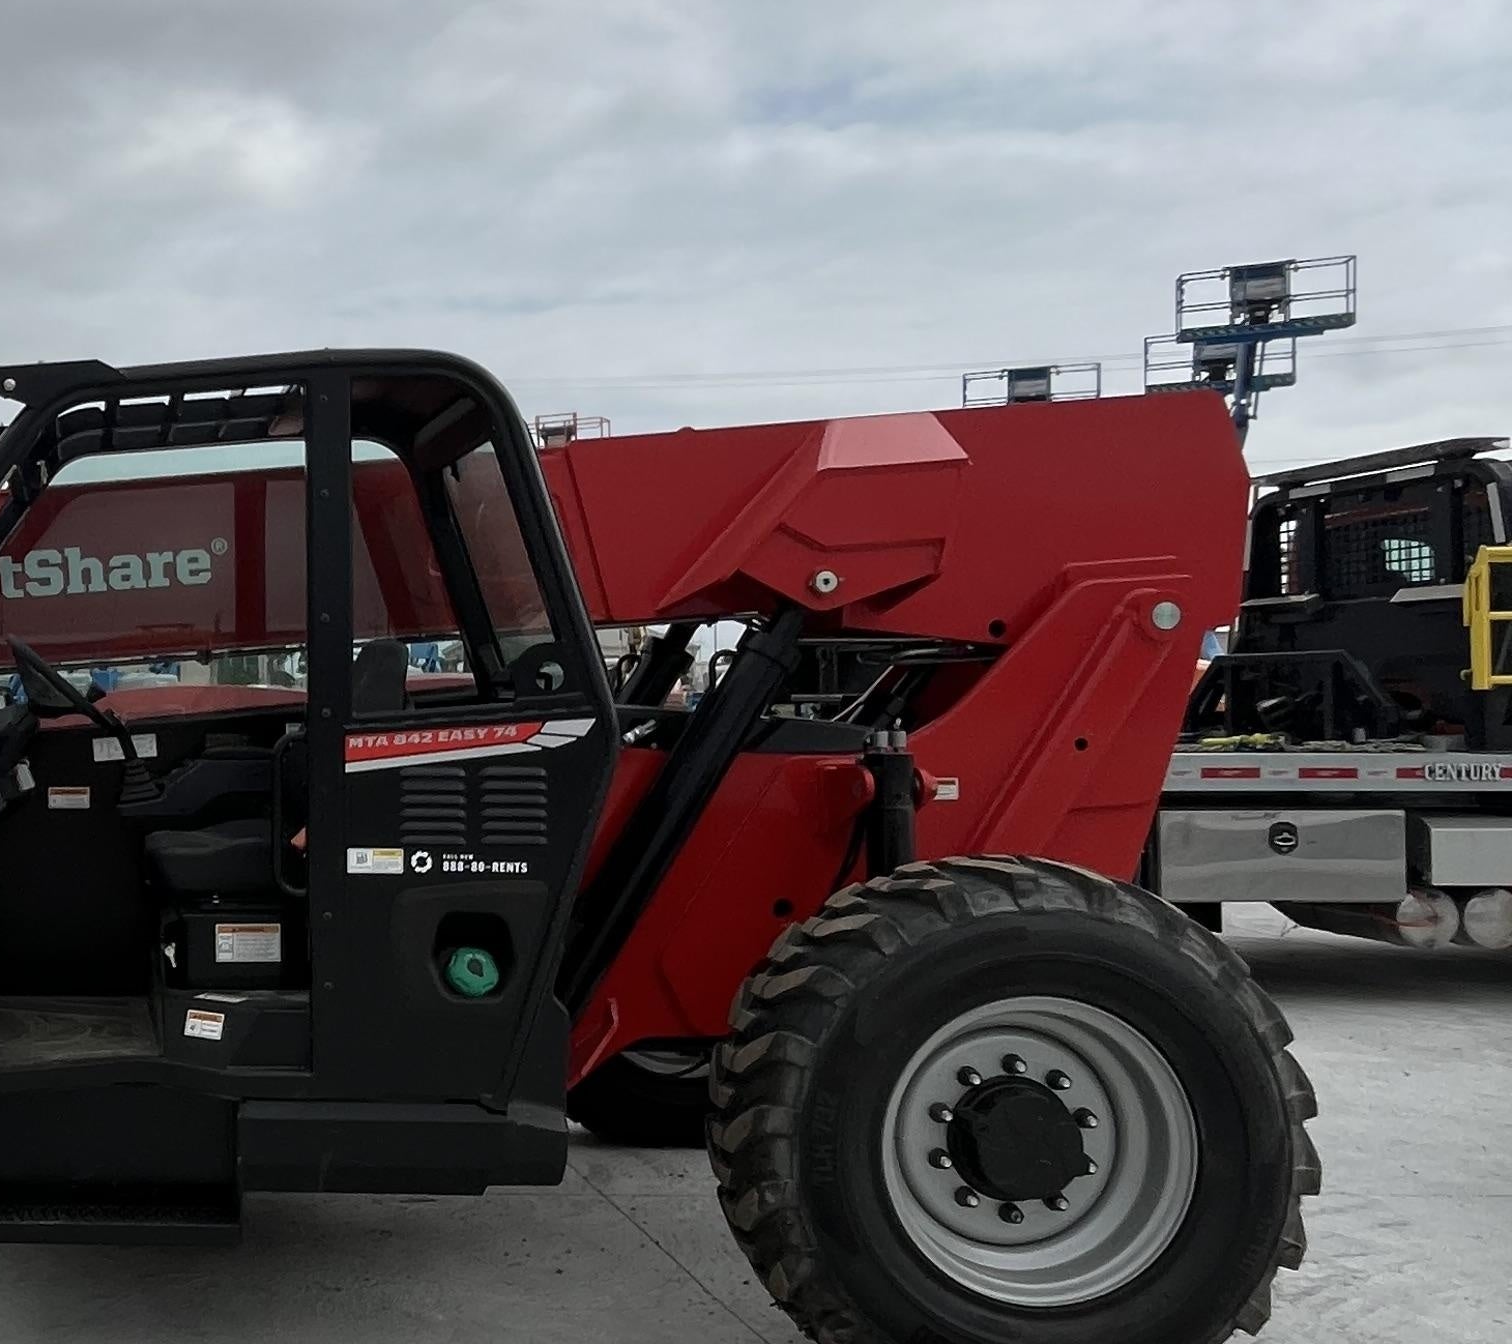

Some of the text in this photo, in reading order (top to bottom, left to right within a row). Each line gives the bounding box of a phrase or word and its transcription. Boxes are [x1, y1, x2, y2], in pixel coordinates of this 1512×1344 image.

[348, 725, 517, 748] MTA 842 EASY 74
[1424, 763, 1502, 781] CENTURY
[442, 860, 528, 873] 888-80-RENTS
